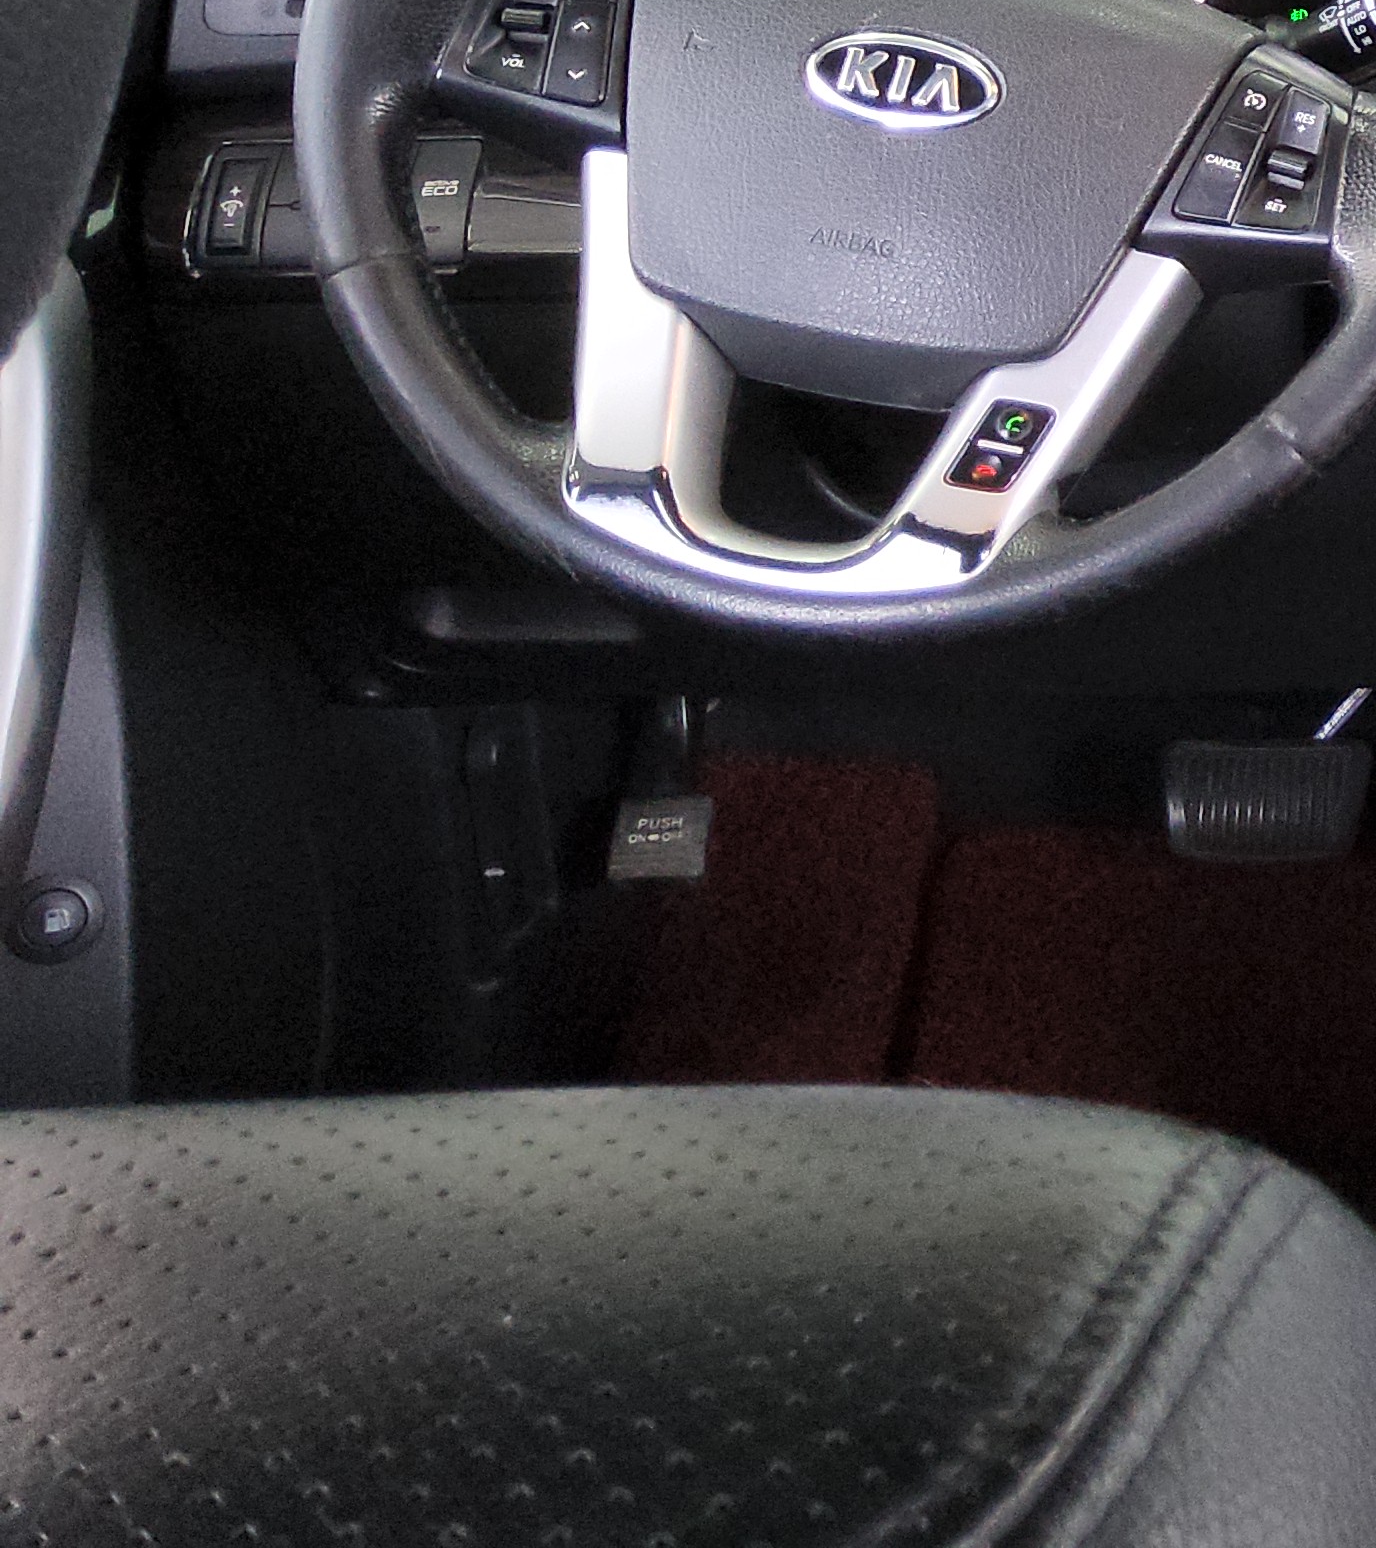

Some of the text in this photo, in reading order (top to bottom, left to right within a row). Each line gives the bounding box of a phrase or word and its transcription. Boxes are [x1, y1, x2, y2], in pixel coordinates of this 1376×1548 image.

[1347, 11, 1367, 26] AUTO
[1354, 25, 1367, 35] LO
[501, 57, 525, 68] VOL
[836, 47, 960, 112] KIA
[1294, 112, 1316, 125] RES
[1204, 154, 1243, 172] CANCEL
[421, 186, 459, 196] ECO
[1264, 202, 1287, 213] SET
[637, 818, 683, 829] PUSH
